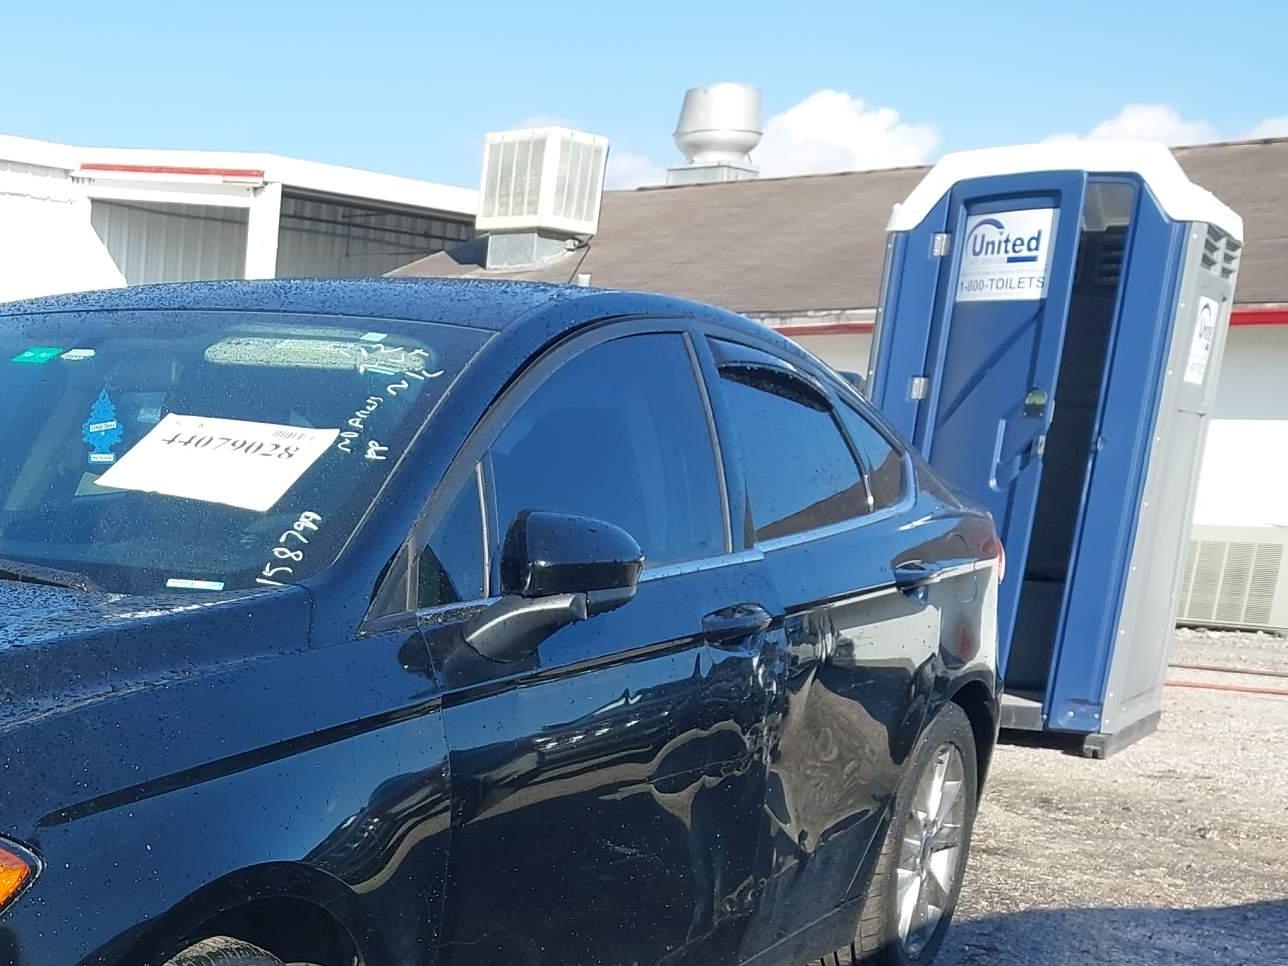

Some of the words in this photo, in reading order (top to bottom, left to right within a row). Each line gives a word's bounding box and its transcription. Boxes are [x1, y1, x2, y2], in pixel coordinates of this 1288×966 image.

[971, 229, 1042, 257] United
[960, 276, 1045, 293] 1-800-TOILETS
[162, 433, 300, 460] 44079028
